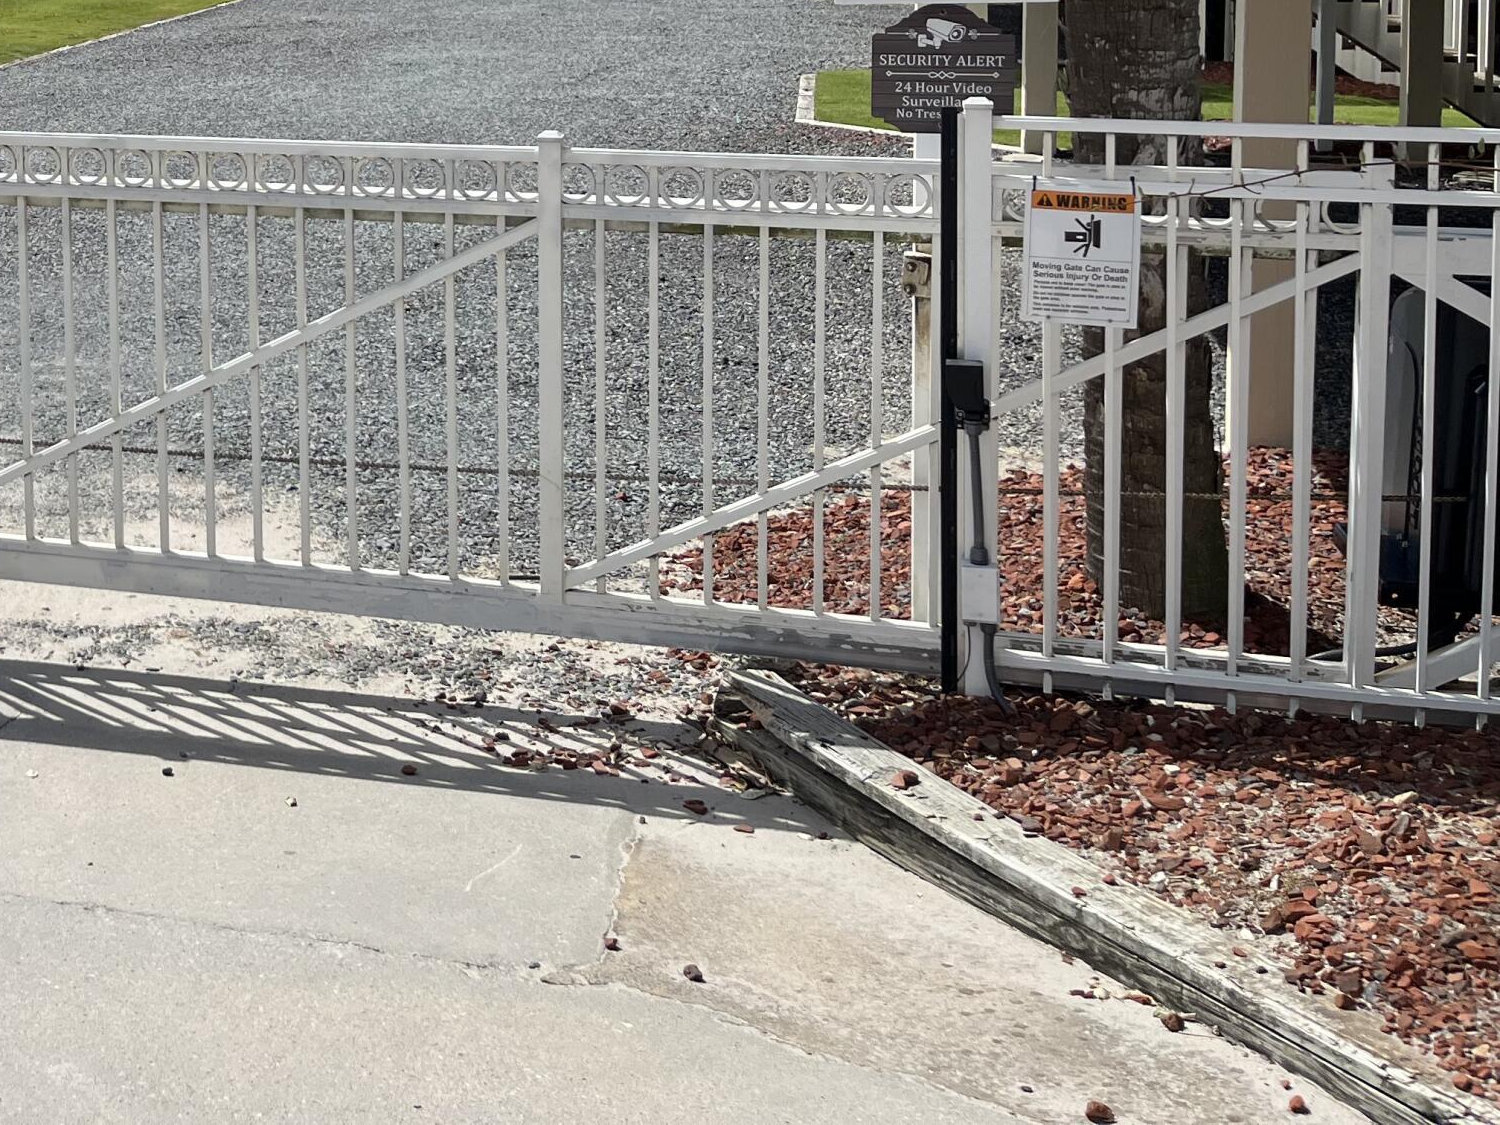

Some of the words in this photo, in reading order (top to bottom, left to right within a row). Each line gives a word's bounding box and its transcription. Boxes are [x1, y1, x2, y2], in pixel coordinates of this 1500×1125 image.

[879, 54, 952, 67] SECURITY
[956, 55, 1005, 67] ALERT
[895, 82, 912, 93] 24
[915, 82, 950, 93] Hour
[953, 82, 992, 94] Video
[902, 96, 962, 107] Surveilla
[896, 108, 913, 119] No
[1057, 194, 1127, 211] WARNING
[1032, 261, 1061, 272] Moving
[1064, 263, 1082, 271] Gate
[1085, 264, 1101, 272] Can
[1104, 265, 1129, 274] Cause
[1033, 270, 1064, 278] Serious
[1066, 272, 1089, 281] Injury
[1092, 273, 1102, 281] Or
[1104, 274, 1128, 282] Death
